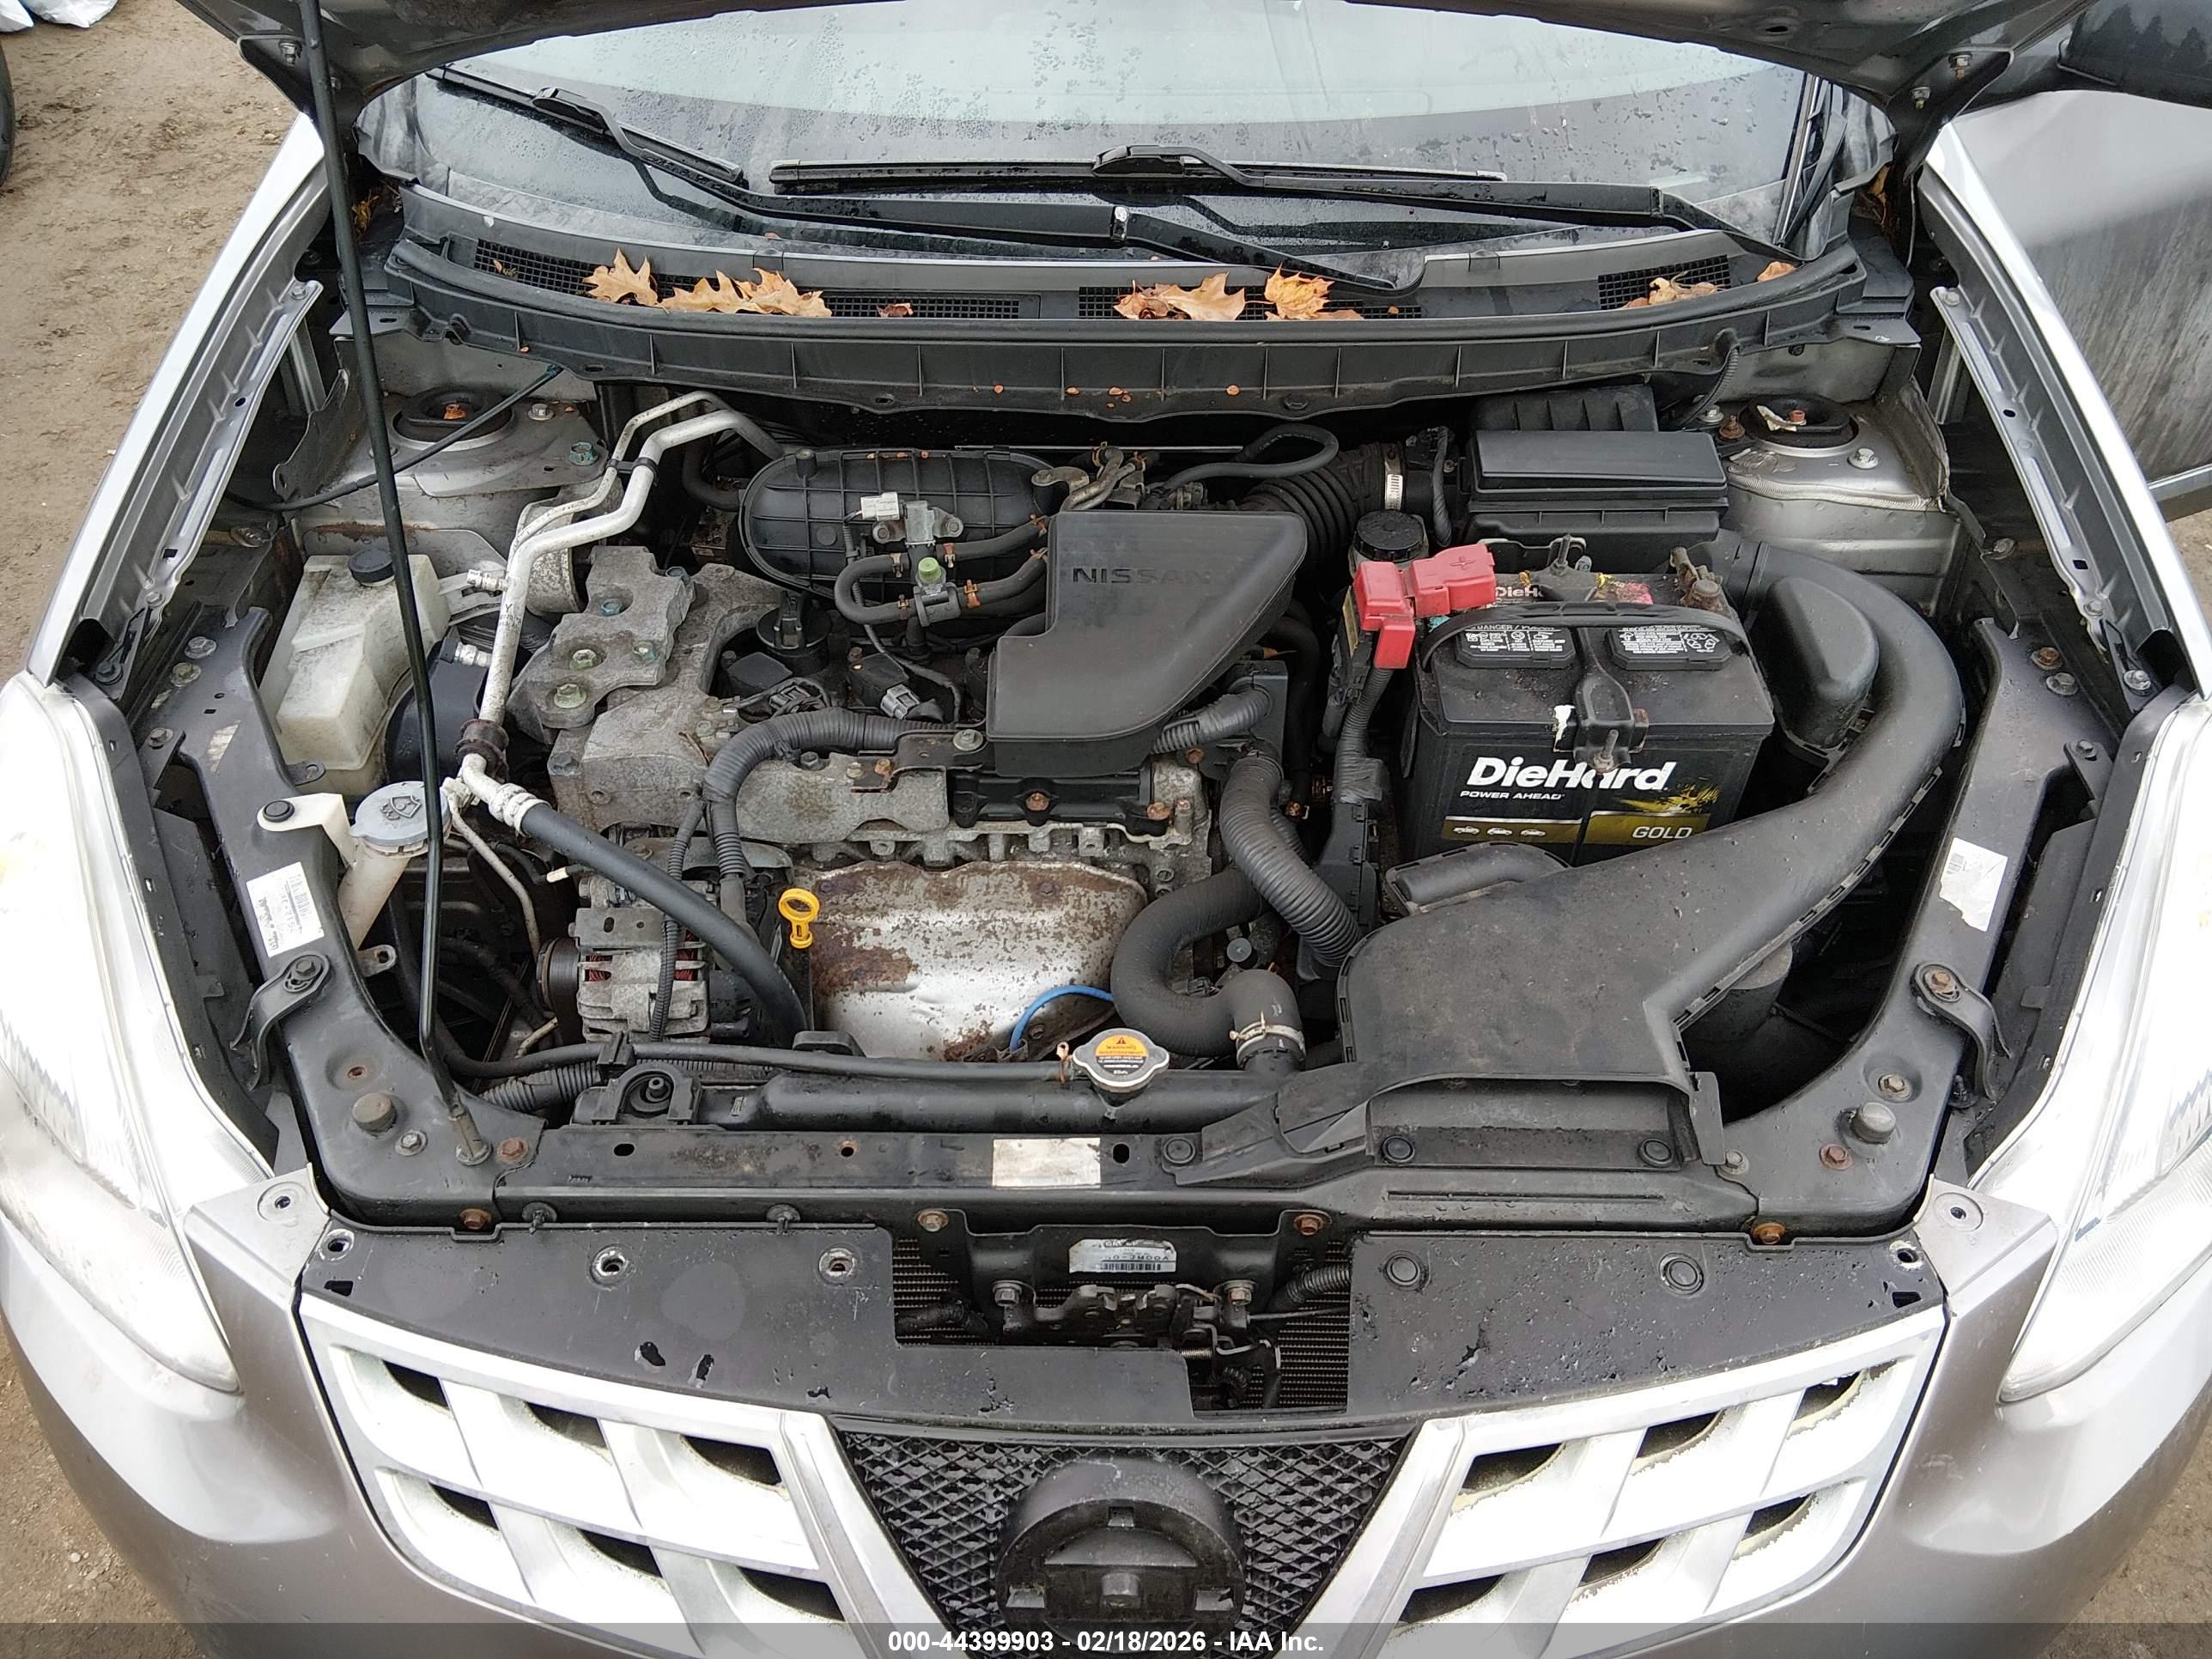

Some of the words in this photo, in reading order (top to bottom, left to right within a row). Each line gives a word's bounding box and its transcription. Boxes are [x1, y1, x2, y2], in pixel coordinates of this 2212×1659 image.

[1073, 568, 1211, 584] NISSAN
[1495, 586, 1544, 597] DieH
[1467, 757, 1676, 791] DieHard
[1460, 790, 1510, 799] POWER
[1632, 826, 1692, 839] GOLD
